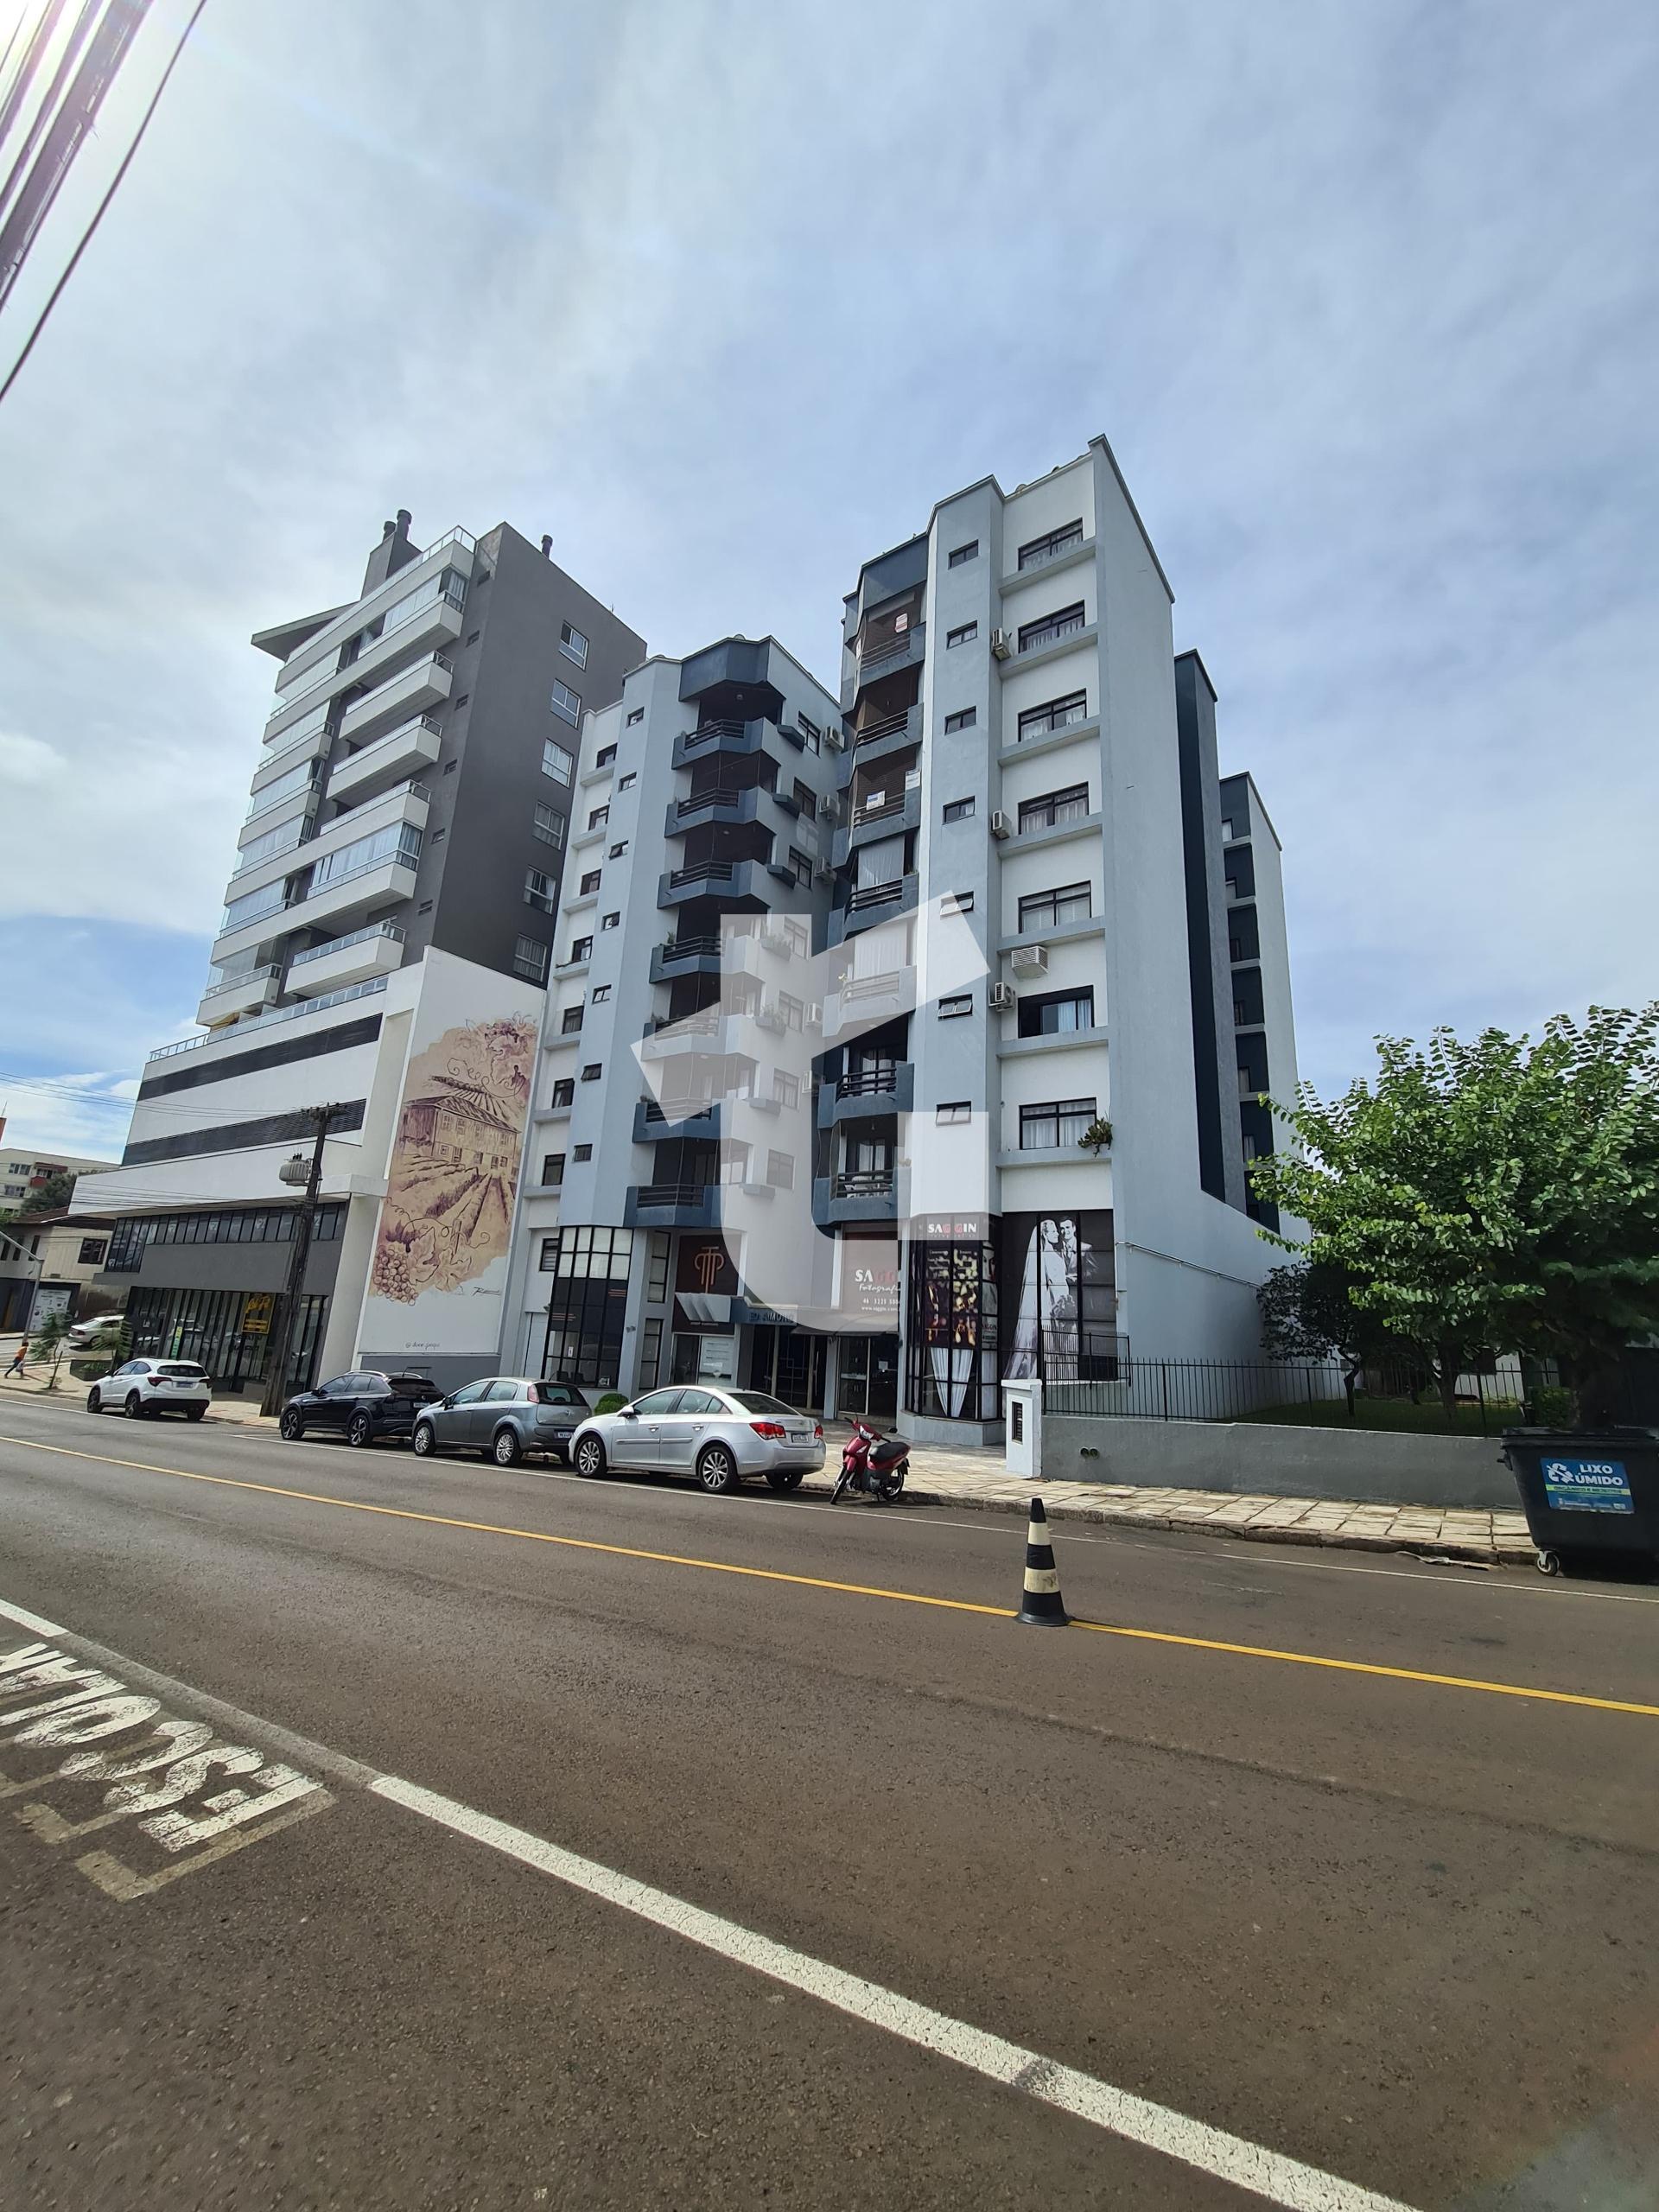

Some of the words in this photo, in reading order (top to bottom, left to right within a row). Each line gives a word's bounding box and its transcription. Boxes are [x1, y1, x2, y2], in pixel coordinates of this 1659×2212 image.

[928, 1223, 976, 1233] SAGGIN
[1580, 1464, 1613, 1474] LIXO
[1575, 1472, 1624, 1486] ÚMIDO
